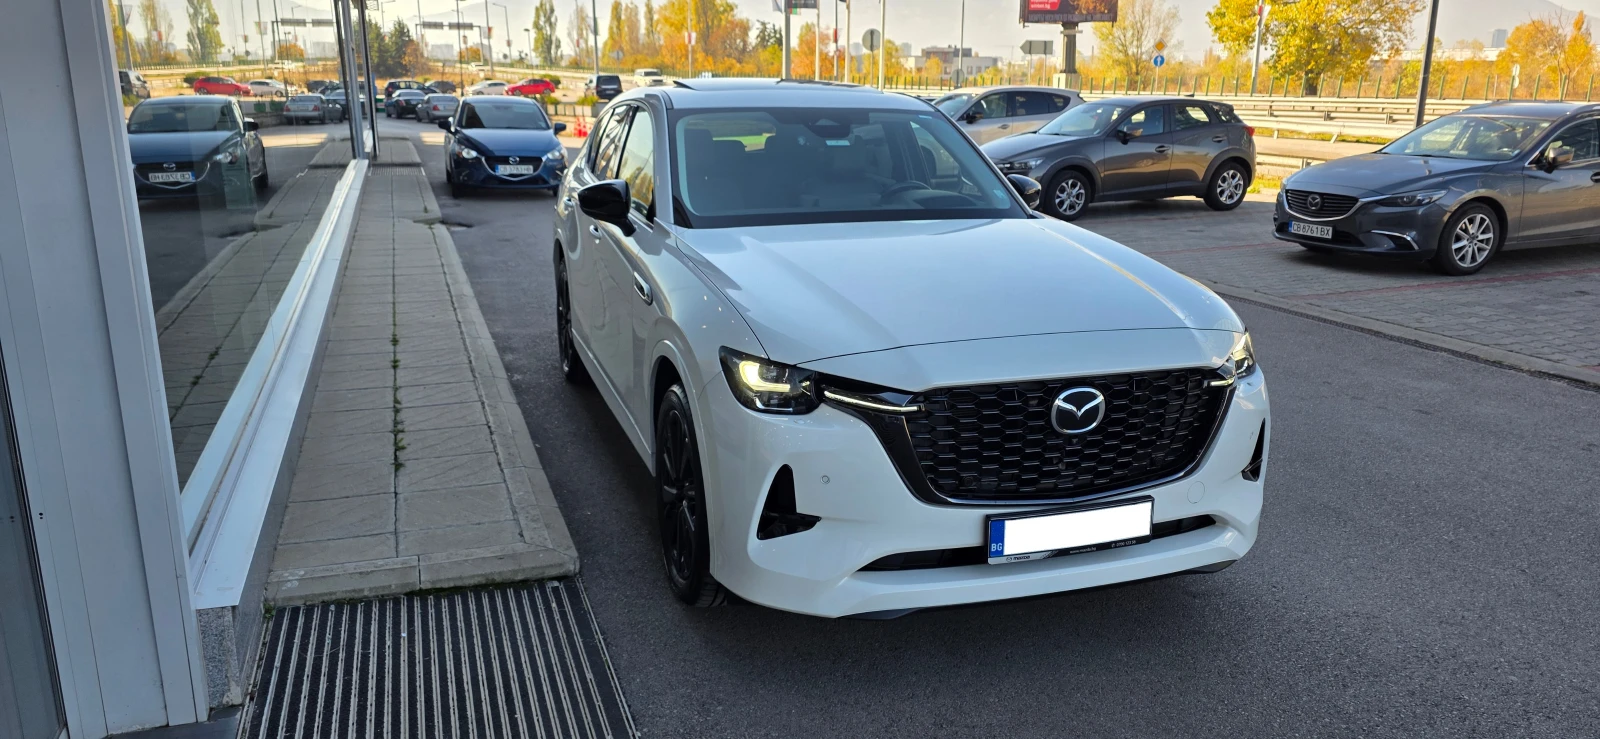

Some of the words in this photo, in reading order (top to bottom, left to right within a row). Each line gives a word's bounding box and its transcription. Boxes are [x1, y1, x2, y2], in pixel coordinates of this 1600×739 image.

[1292, 222, 1301, 232] CB
[1302, 224, 1319, 235] 8761
[1320, 226, 1331, 237] BX
[991, 542, 1003, 552] BG
